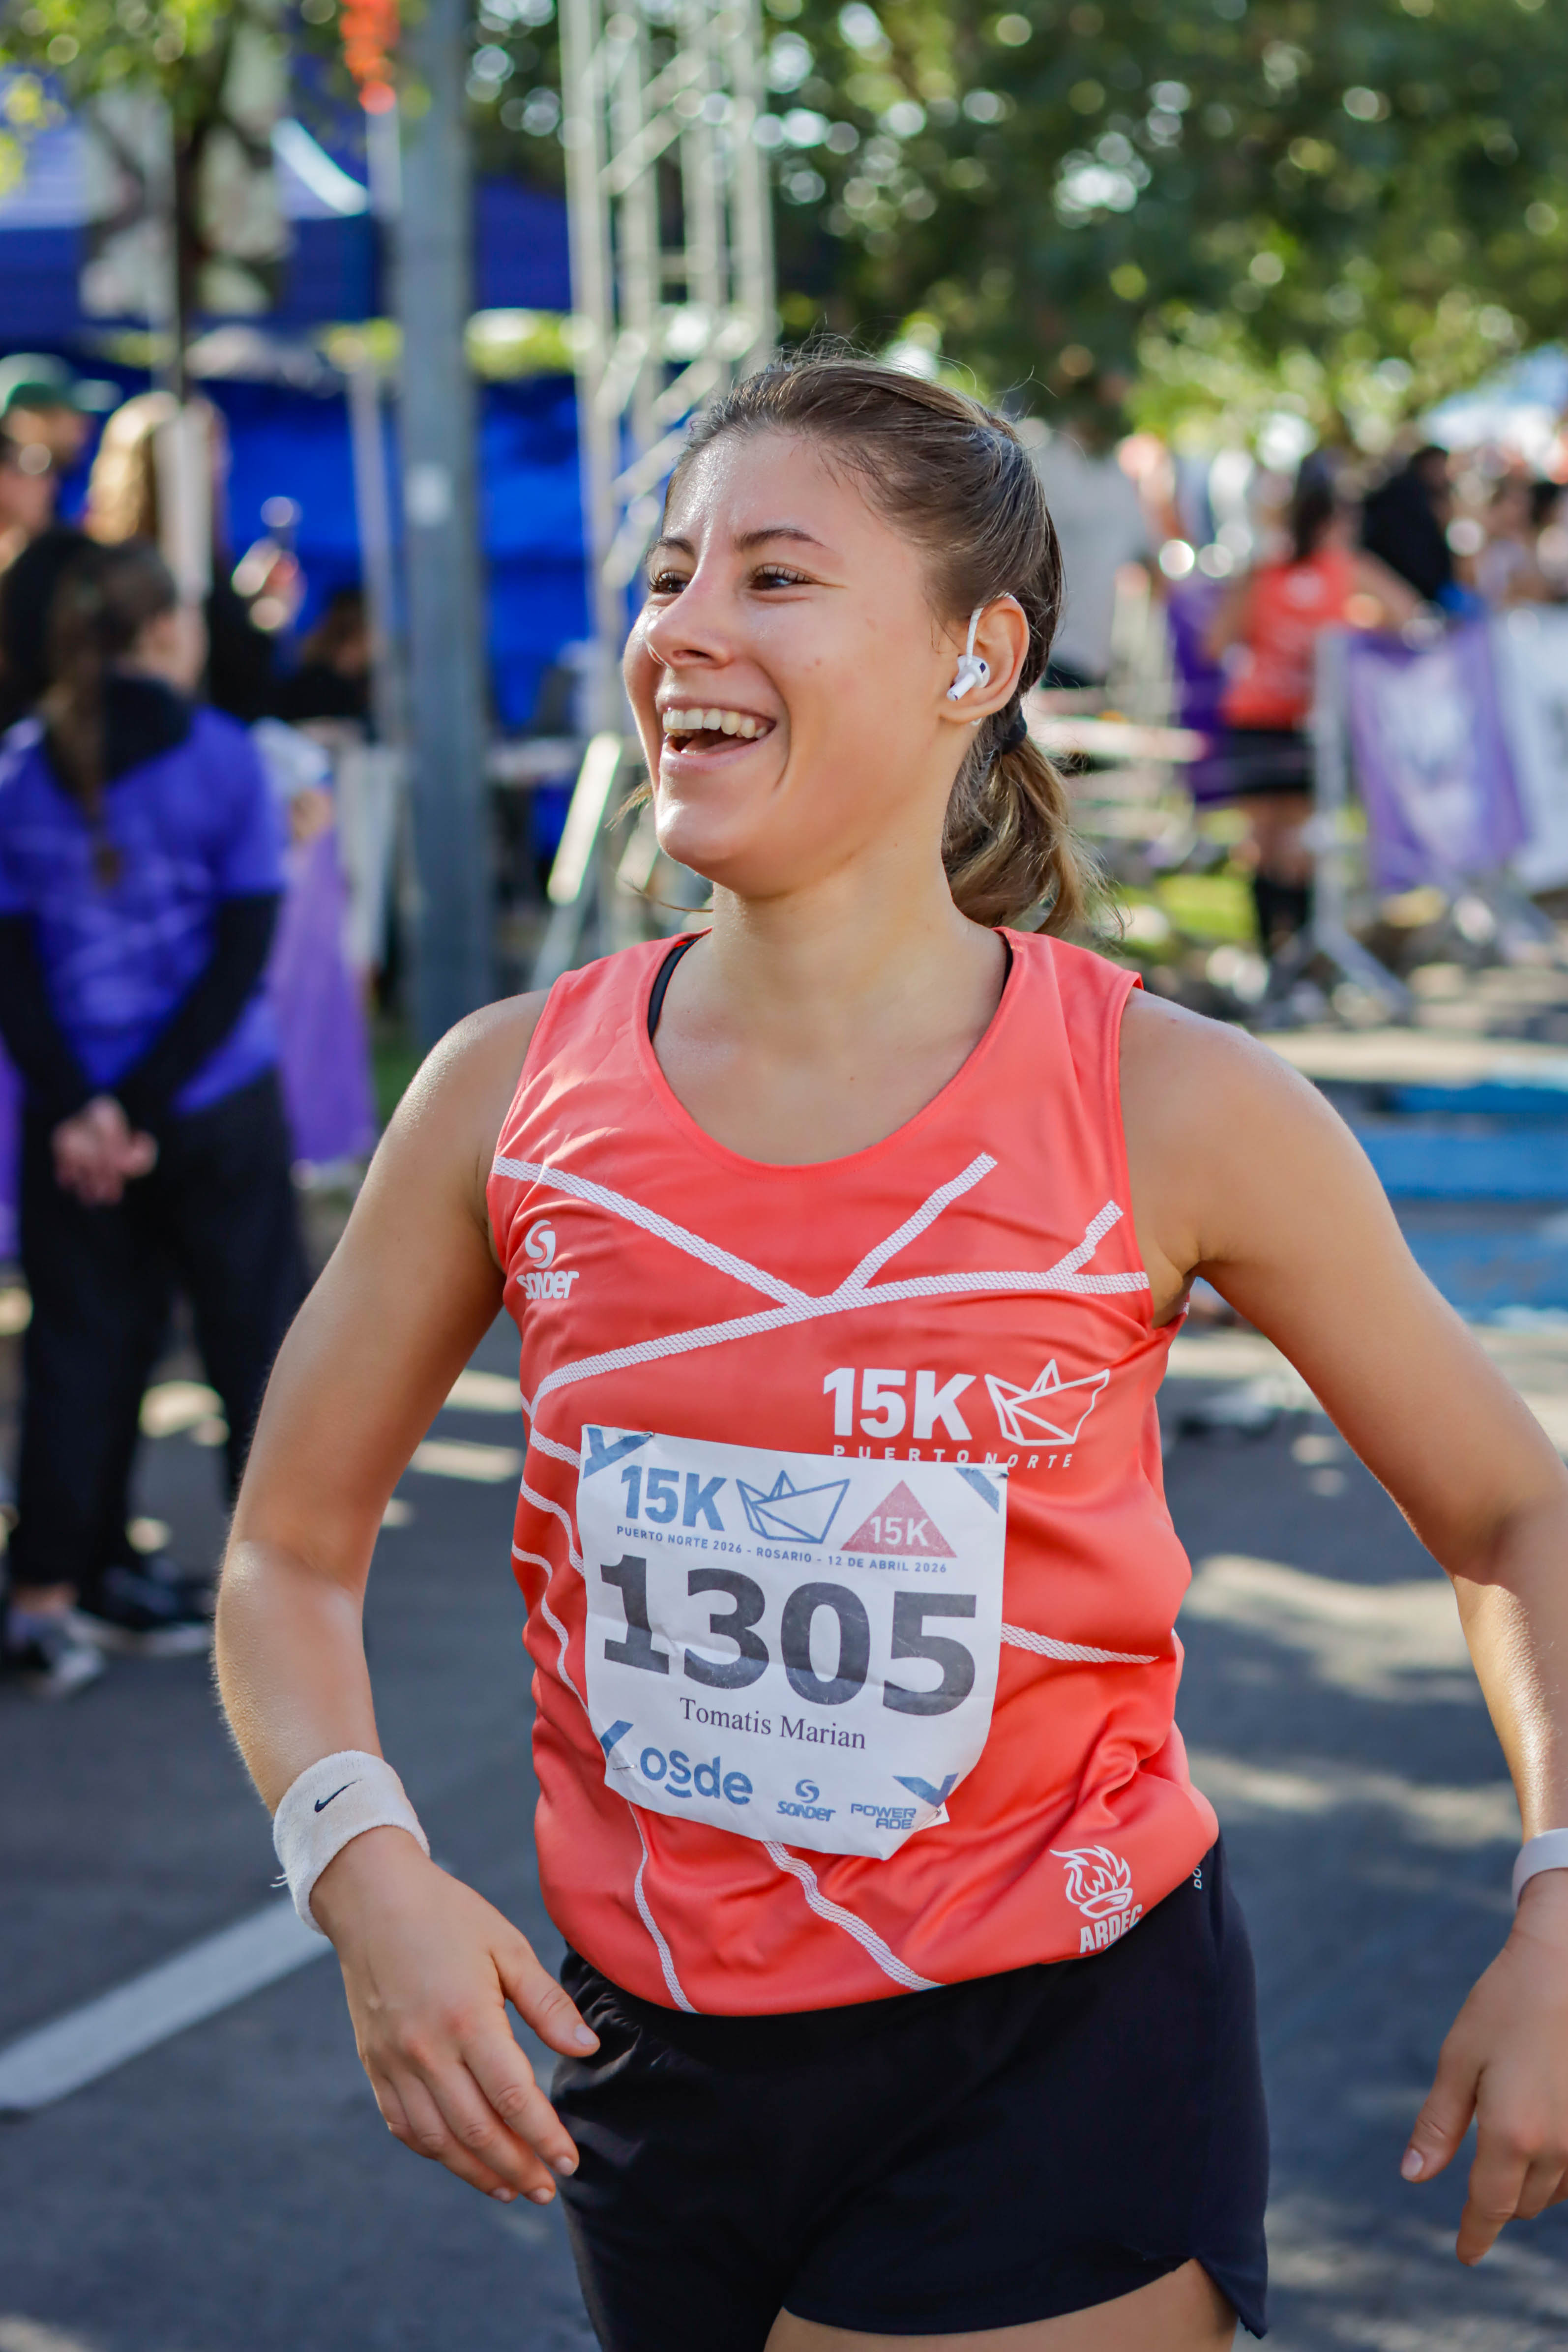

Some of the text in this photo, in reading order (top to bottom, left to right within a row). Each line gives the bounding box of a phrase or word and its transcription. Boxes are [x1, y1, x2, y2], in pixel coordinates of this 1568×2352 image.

[823, 1367, 976, 1441] 15K
[833, 1444, 1073, 1469] PUERTO NORTE
[620, 1465, 727, 1531] 15K
[617, 1526, 663, 1542] PUERTO
[668, 1534, 708, 1549] NORTE
[713, 1540, 742, 1554] 2026
[756, 1547, 812, 1563] ROSARIO
[828, 1556, 842, 1566] 12
[848, 1557, 864, 1568] DE
[869, 1559, 909, 1572] ABRIL
[914, 1562, 947, 1573] 2026
[869, 1516, 930, 1547] 15K
[600, 1554, 977, 1717] 1305
[680, 1697, 866, 1749] Tomatis Marian
[640, 1746, 753, 1805] osde
[851, 1803, 917, 1819] POWER
